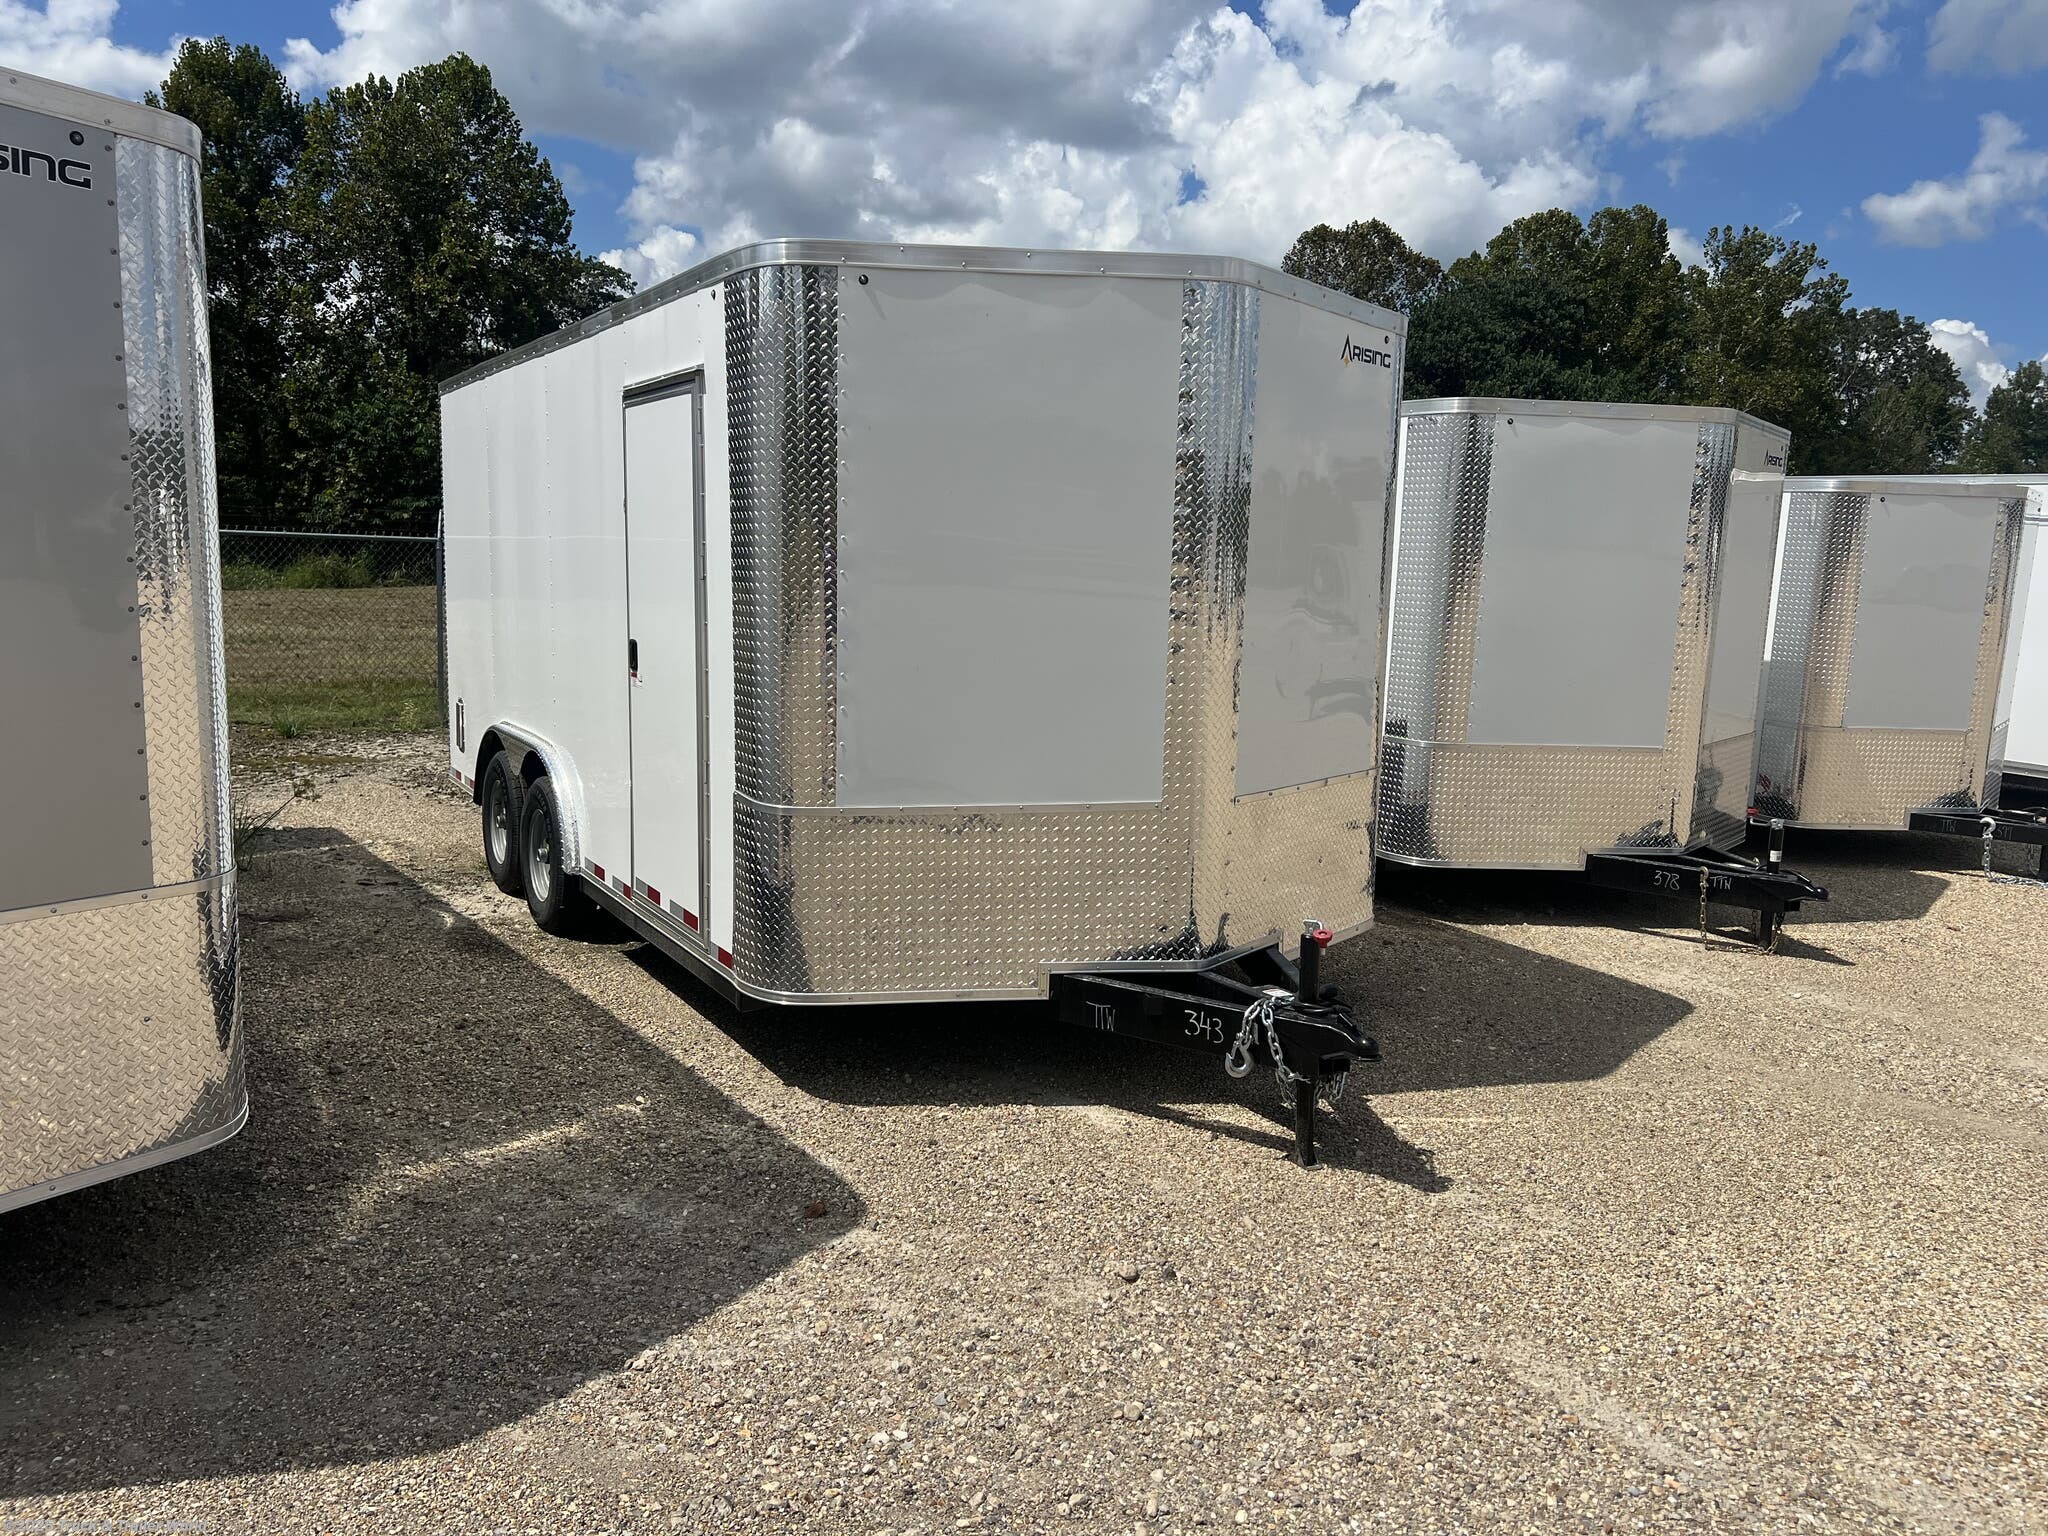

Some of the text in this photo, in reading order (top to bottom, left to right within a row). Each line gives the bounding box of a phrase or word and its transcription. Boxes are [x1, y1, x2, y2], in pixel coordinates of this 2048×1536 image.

[1341, 334, 1391, 368] ARISING
[1654, 870, 1680, 890] 378
[1085, 1001, 1225, 1044] TTW 343
